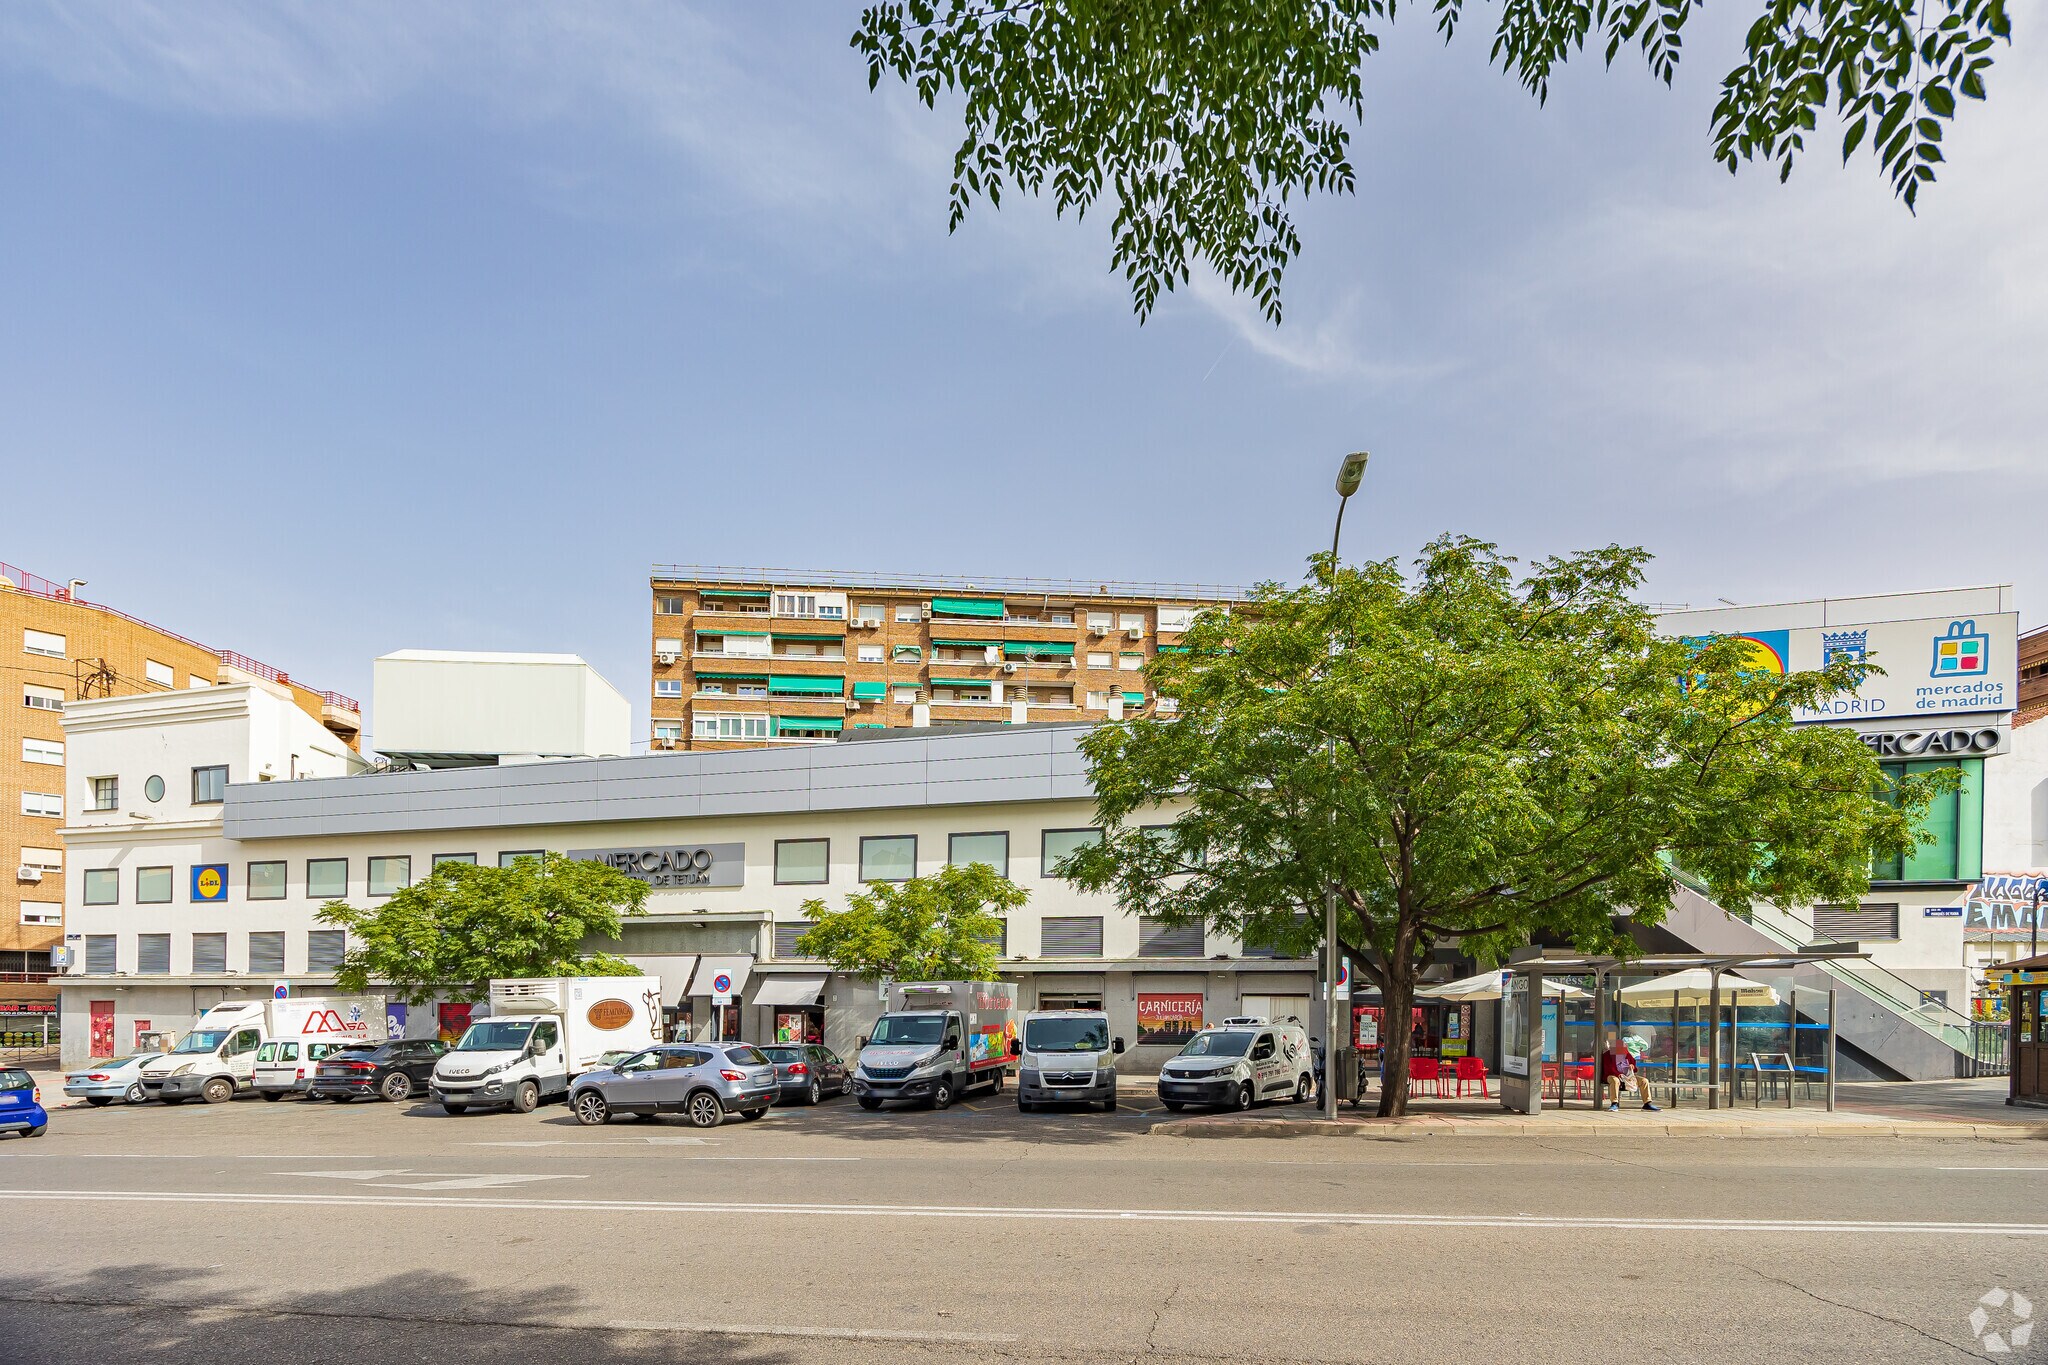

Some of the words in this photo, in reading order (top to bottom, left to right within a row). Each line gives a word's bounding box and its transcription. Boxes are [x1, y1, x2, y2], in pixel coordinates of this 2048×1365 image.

[1916, 680, 2003, 696] mercados
[1802, 698, 1886, 716] MADRID
[1916, 697, 1936, 709] de
[1941, 693, 2003, 708] madrid
[1862, 728, 2001, 754] ERCADO
[655, 874, 670, 886] DE
[671, 871, 712, 885] TETUÁN
[1139, 999, 1203, 1016] CARNICERÍA
